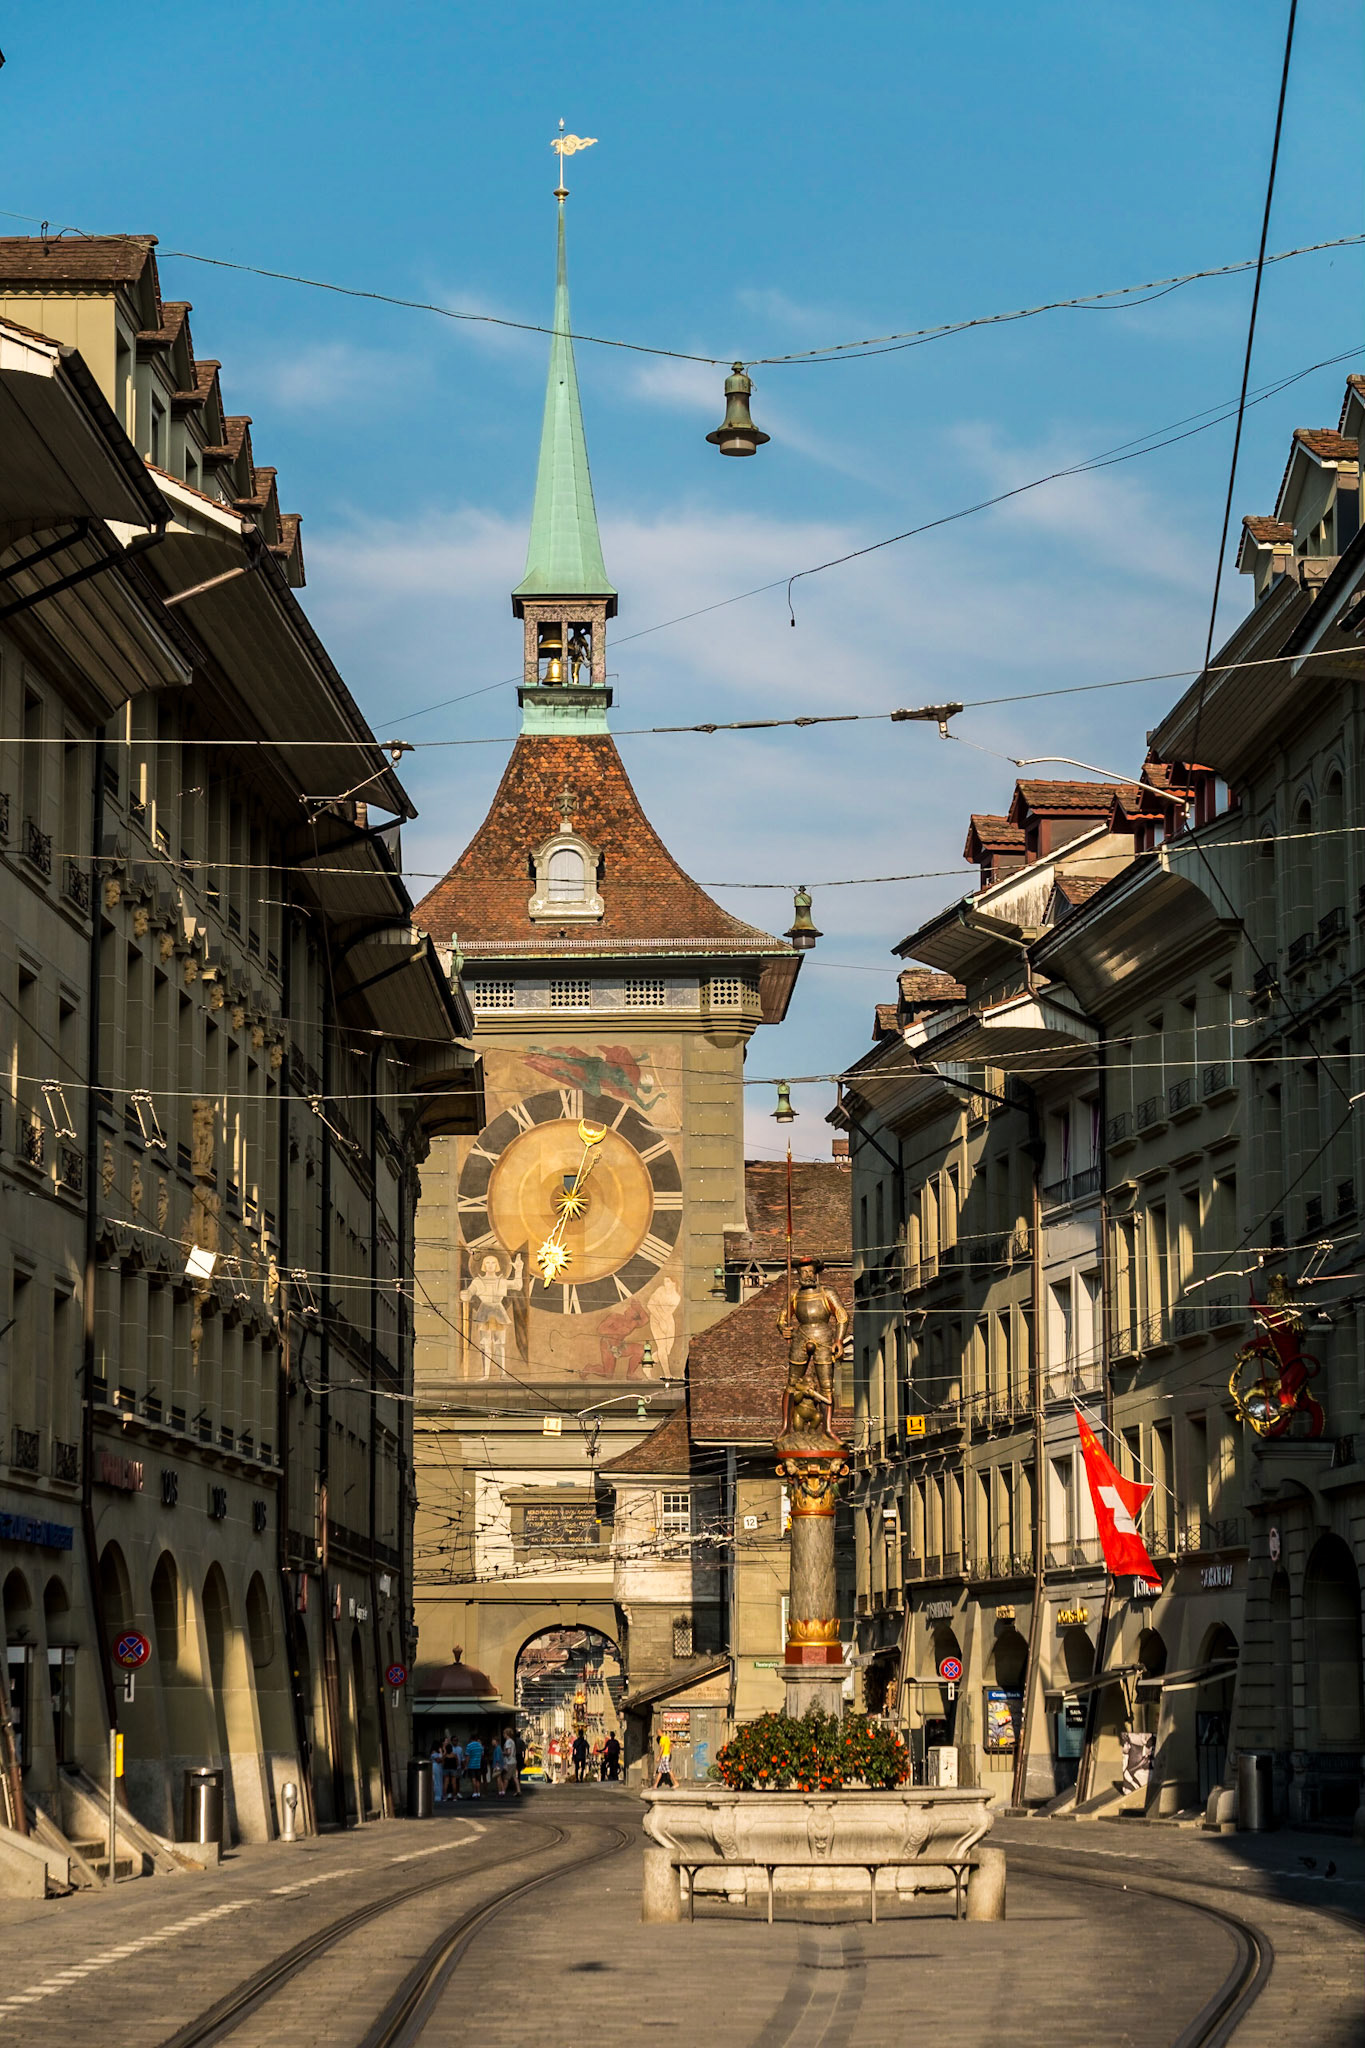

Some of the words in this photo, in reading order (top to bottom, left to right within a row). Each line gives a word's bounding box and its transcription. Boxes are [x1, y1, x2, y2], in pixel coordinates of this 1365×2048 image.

[559, 1089, 584, 1119] XII
[507, 1101, 536, 1135] XI
[469, 1142, 501, 1167] X
[639, 1140, 670, 1163] II
[653, 1191, 683, 1211] III
[746, 1518, 755, 1527] 12
